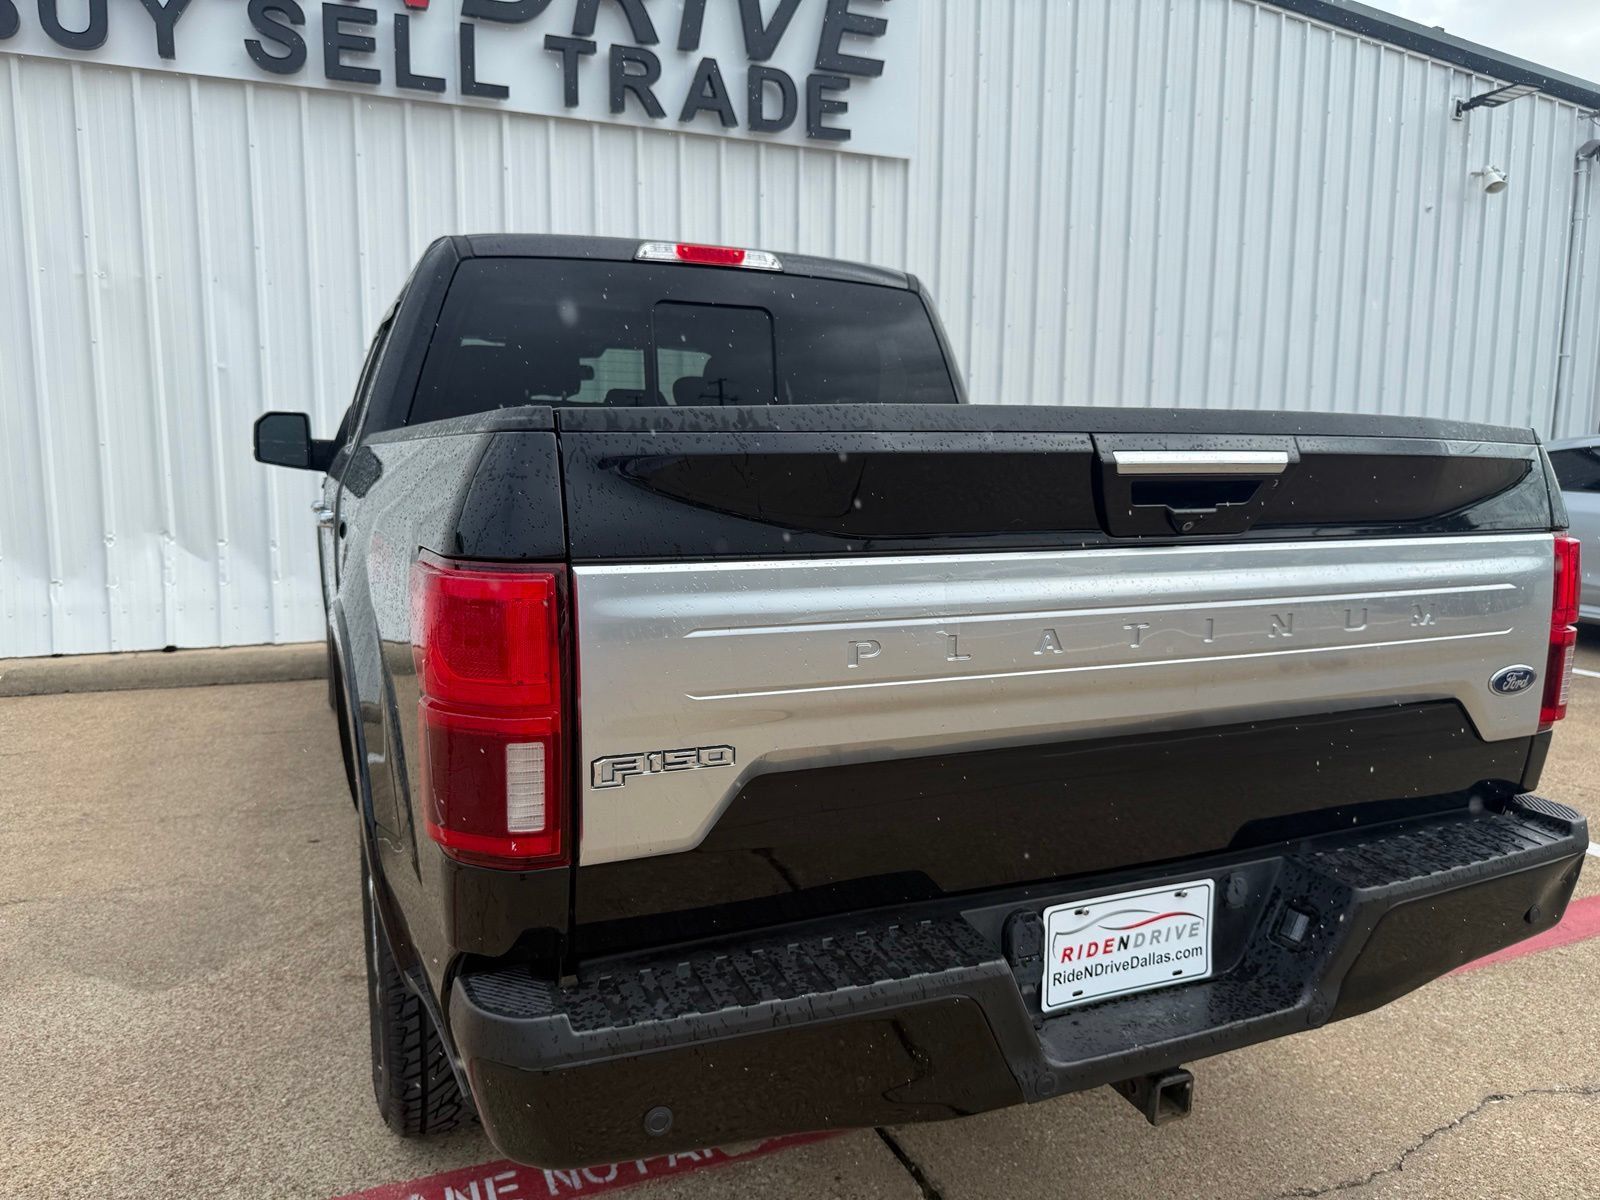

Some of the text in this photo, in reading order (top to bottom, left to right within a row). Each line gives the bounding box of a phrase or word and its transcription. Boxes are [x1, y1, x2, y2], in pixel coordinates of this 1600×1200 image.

[0, 0, 852, 141] UY SELL TRADE
[847, 602, 1436, 669] PLATINUM
[1052, 944, 1203, 987] RideNDriveDallas.com
[1060, 921, 1201, 964] RIDENDRIVE
